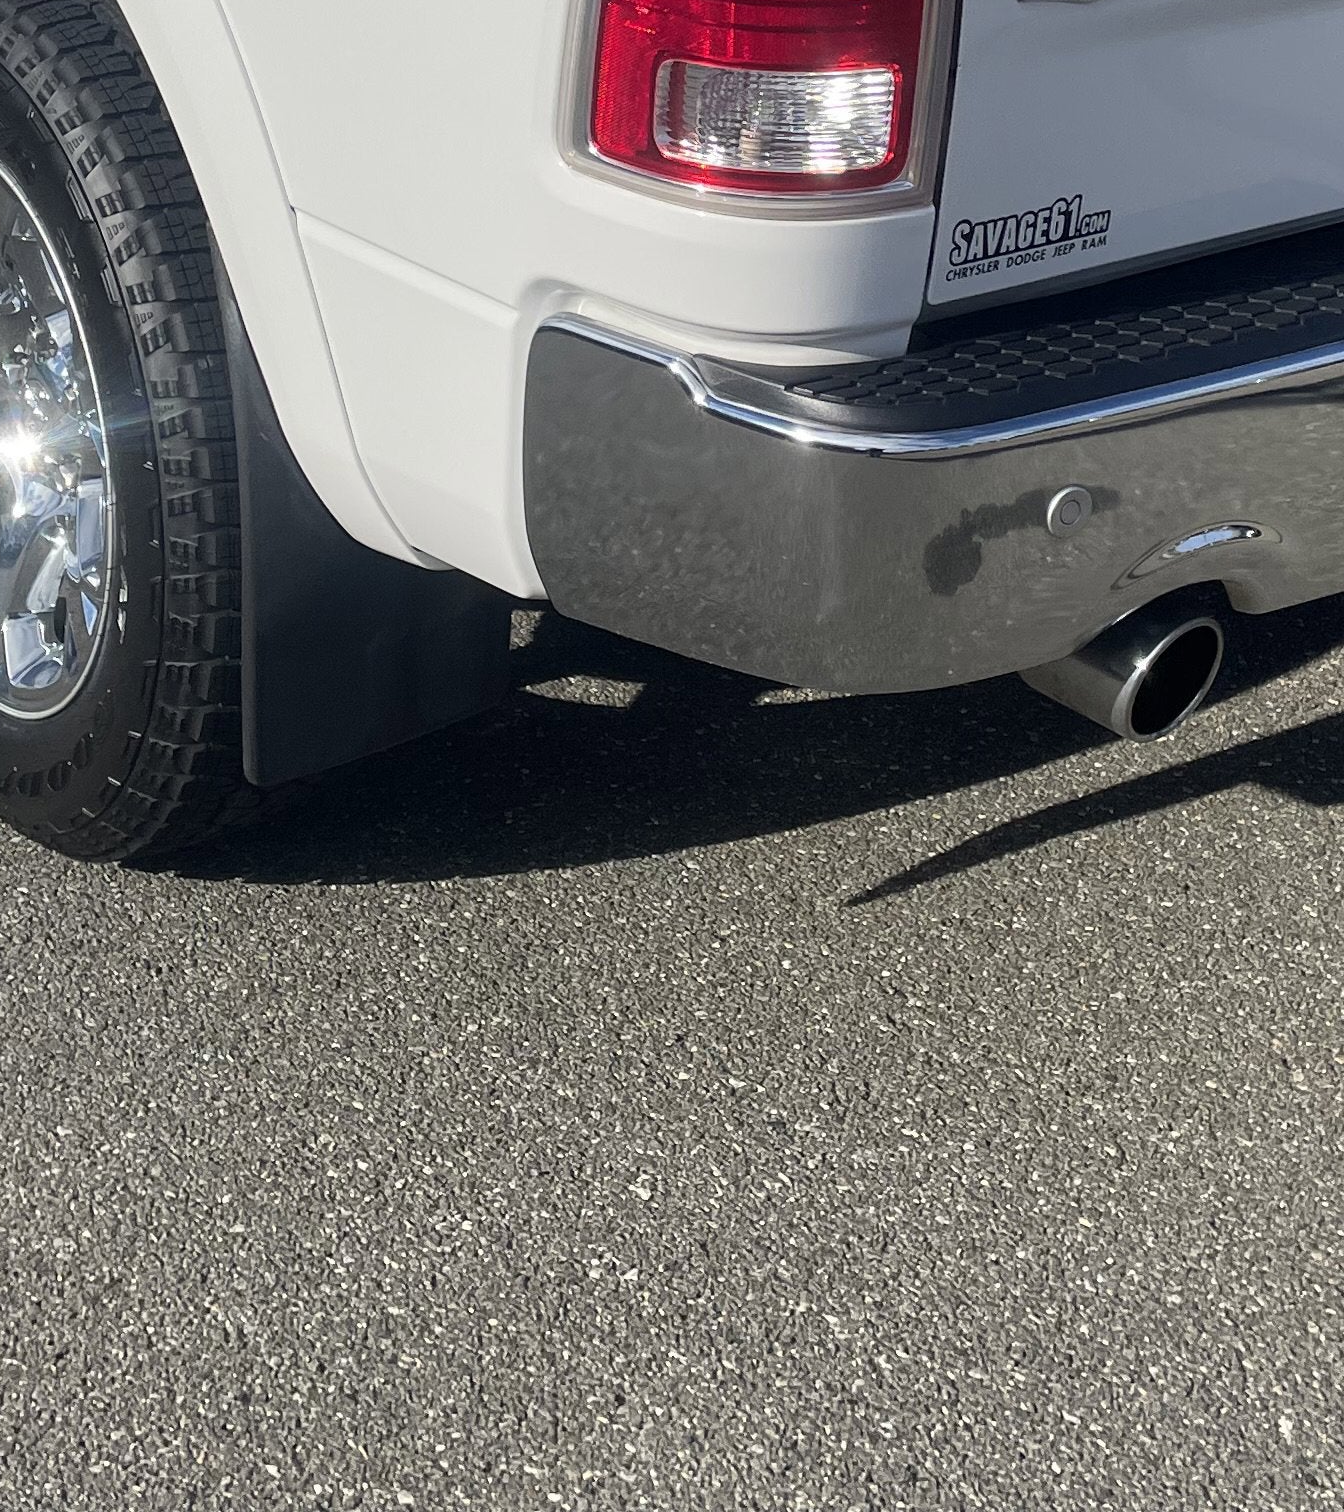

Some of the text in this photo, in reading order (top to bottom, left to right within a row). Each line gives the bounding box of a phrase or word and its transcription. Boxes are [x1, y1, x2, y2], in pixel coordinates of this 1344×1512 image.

[945, 235, 1108, 282] CHRYSLER DODGE JEEP RAM
